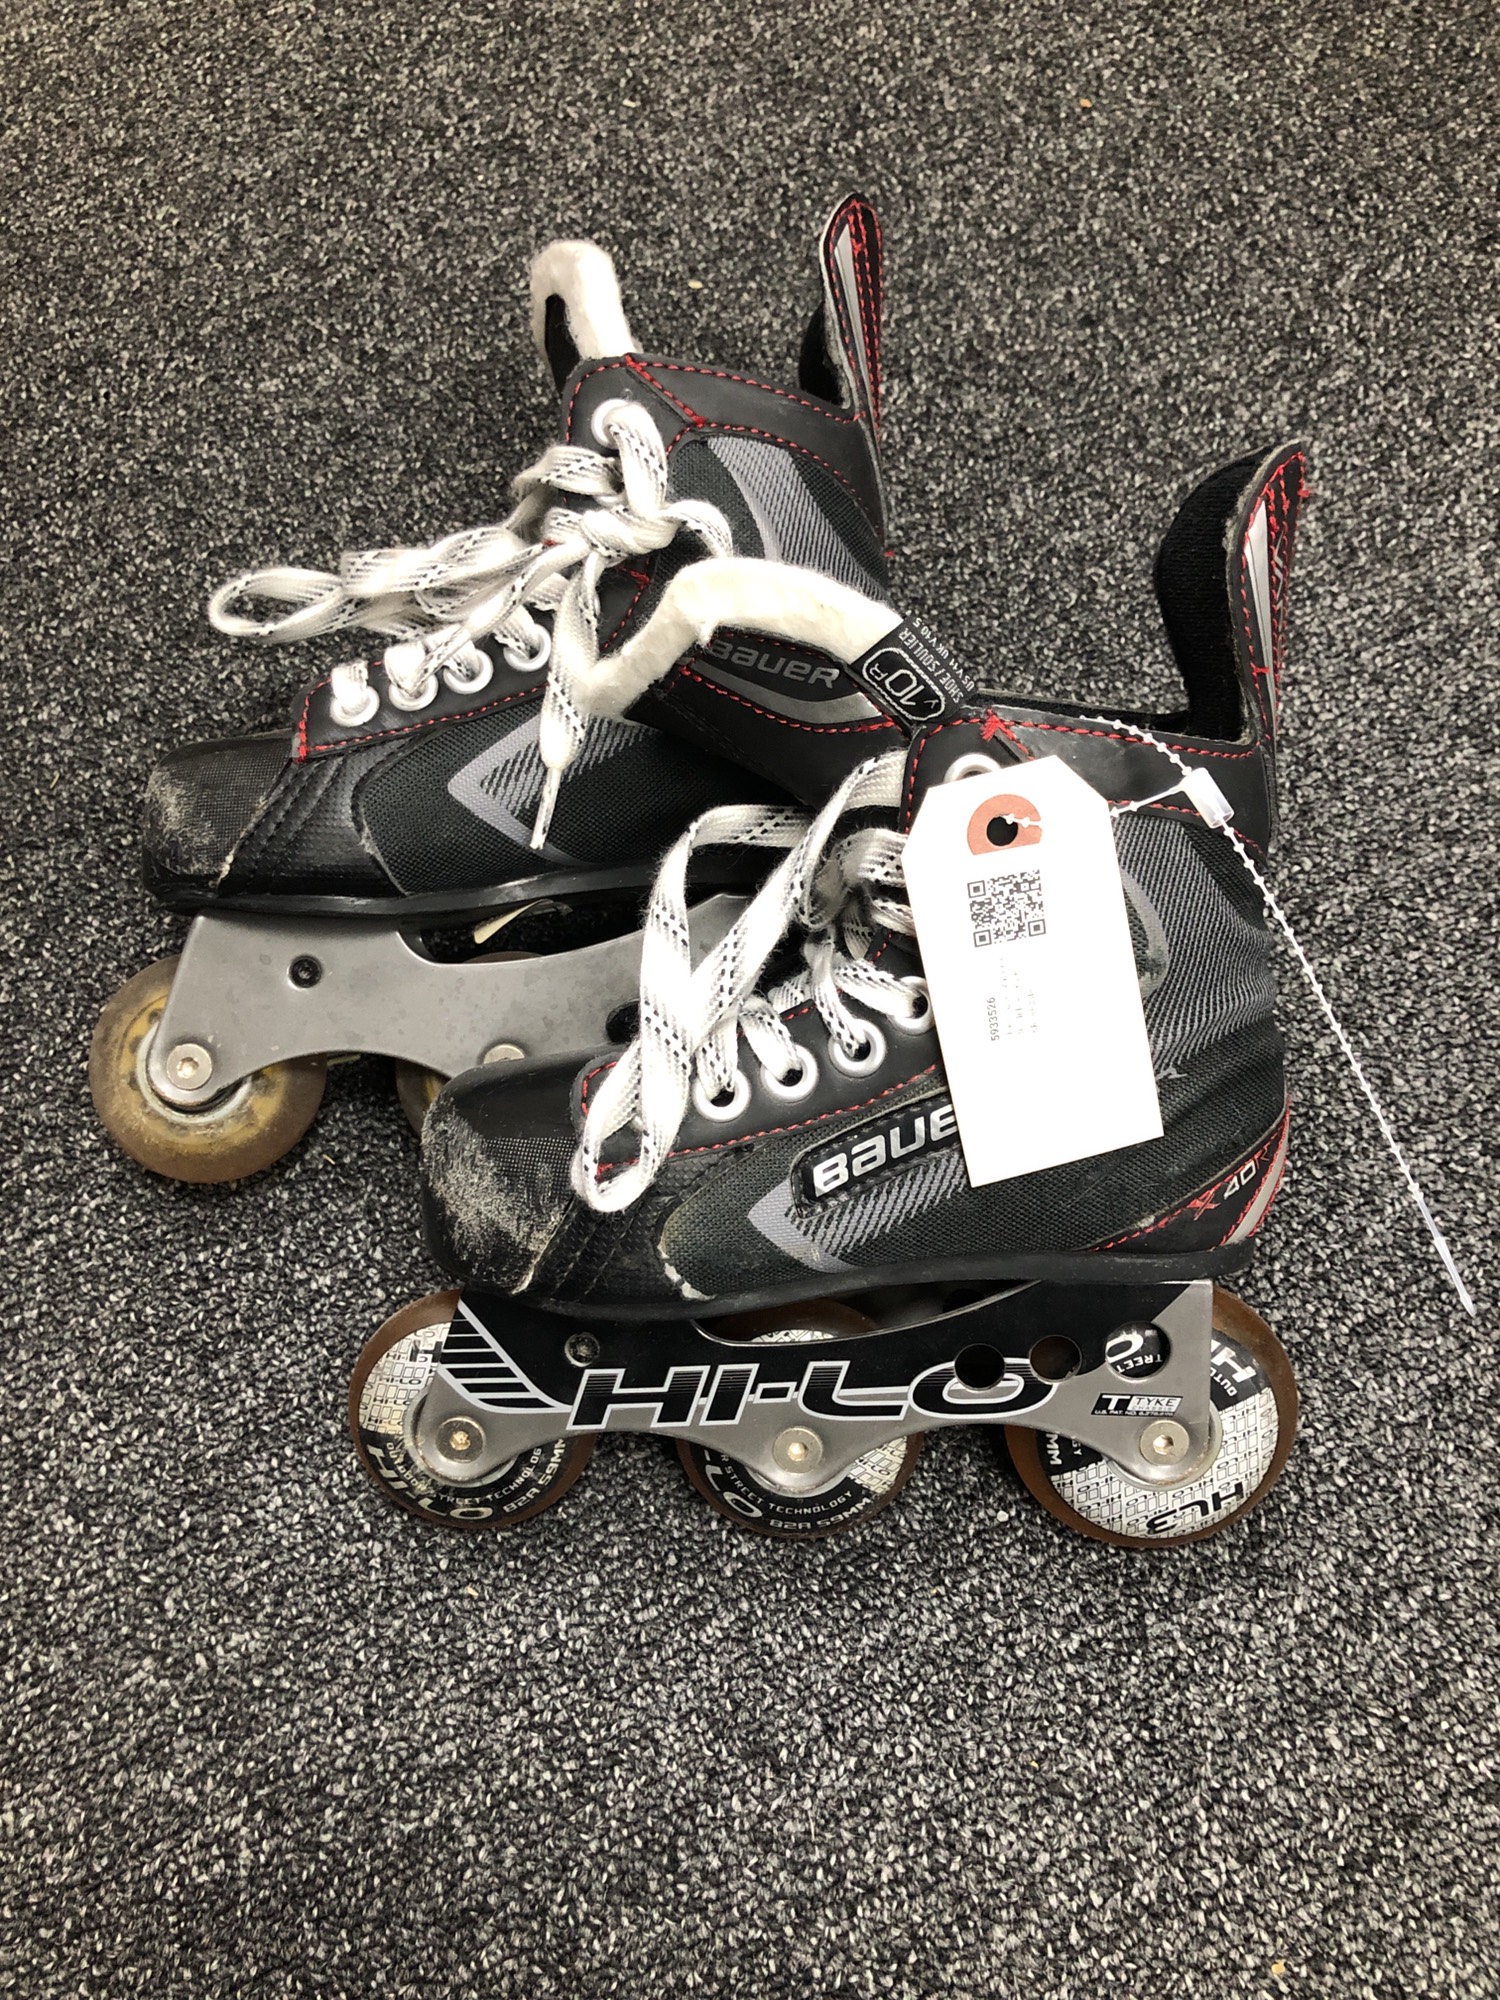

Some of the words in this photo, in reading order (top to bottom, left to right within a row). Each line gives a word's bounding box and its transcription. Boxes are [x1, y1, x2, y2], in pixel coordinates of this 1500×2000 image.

[885, 668, 925, 706] 10
[986, 996, 1001, 1042] 5933526
[812, 1104, 959, 1197] BAUE
[1115, 1353, 1163, 1373] TREET
[566, 1359, 1058, 1430] HI-LO
[1136, 1397, 1177, 1407] TYKE
[366, 1443, 493, 1520] HI-LO
[485, 1447, 543, 1502] TECHNOLOG
[724, 1465, 765, 1505] STREET
[767, 1489, 855, 1515] TECHNOLOGY
[815, 1496, 872, 1529] 59MM
[1145, 1481, 1245, 1536] HL3
